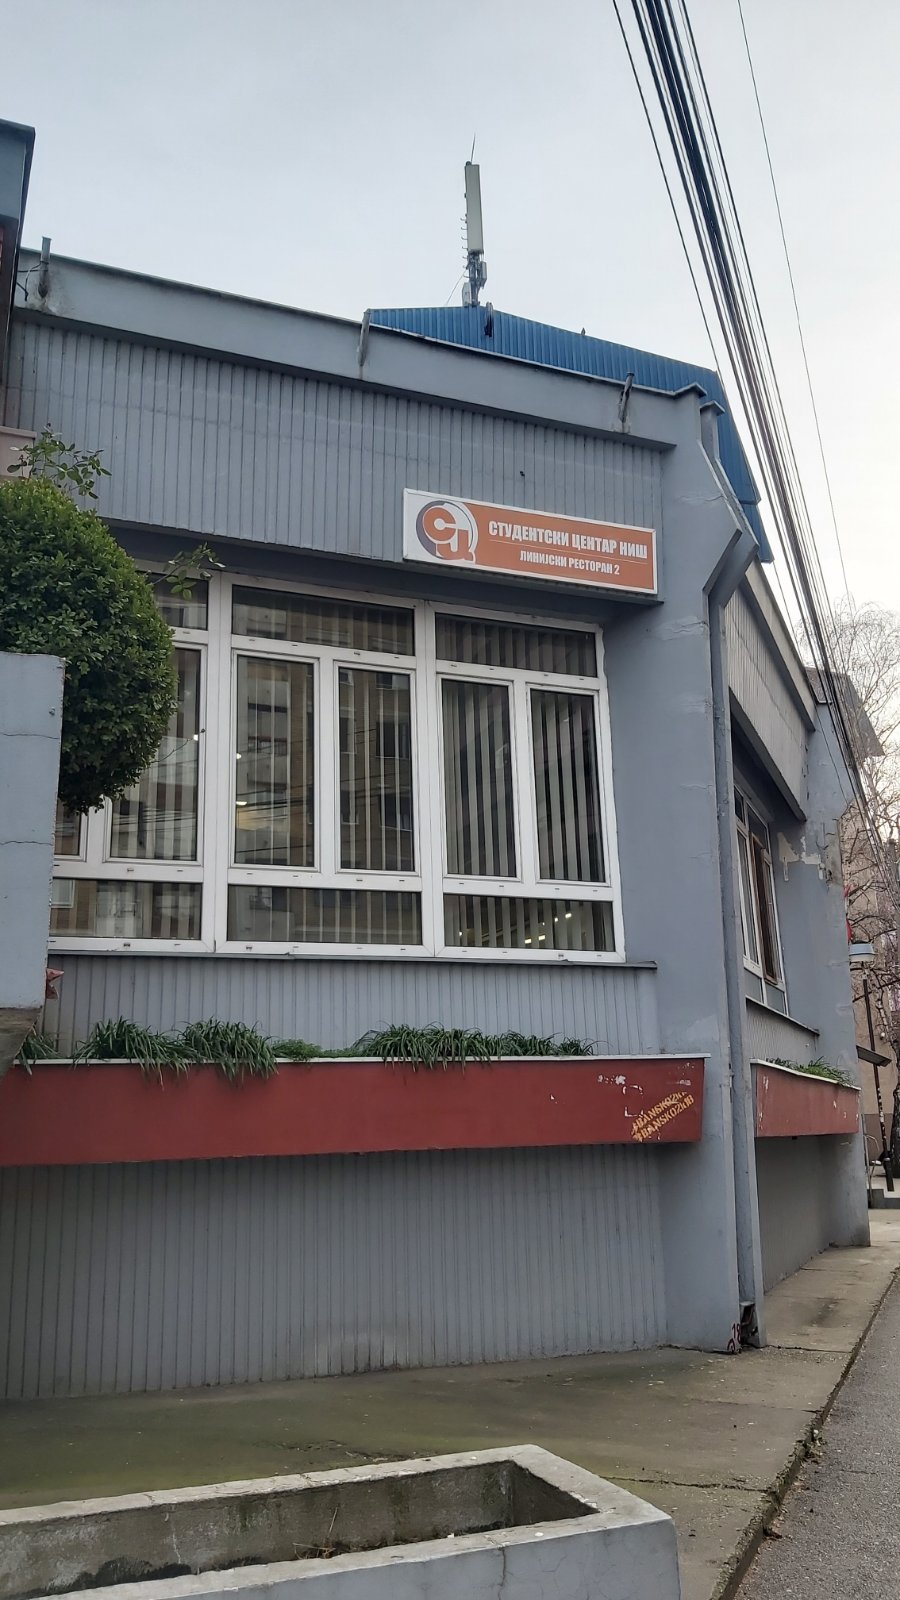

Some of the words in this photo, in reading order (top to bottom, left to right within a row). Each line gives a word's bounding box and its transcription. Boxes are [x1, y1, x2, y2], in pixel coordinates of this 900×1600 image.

[488, 520, 570, 547] СТУДЕНТСКИ
[571, 533, 618, 554] ЦЕНТАР
[619, 541, 648, 559] НИШ
[519, 550, 567, 567] ЛИНИЈСКИ
[568, 557, 613, 574] РЕСТОРАН
[614, 564, 620, 575] 2
